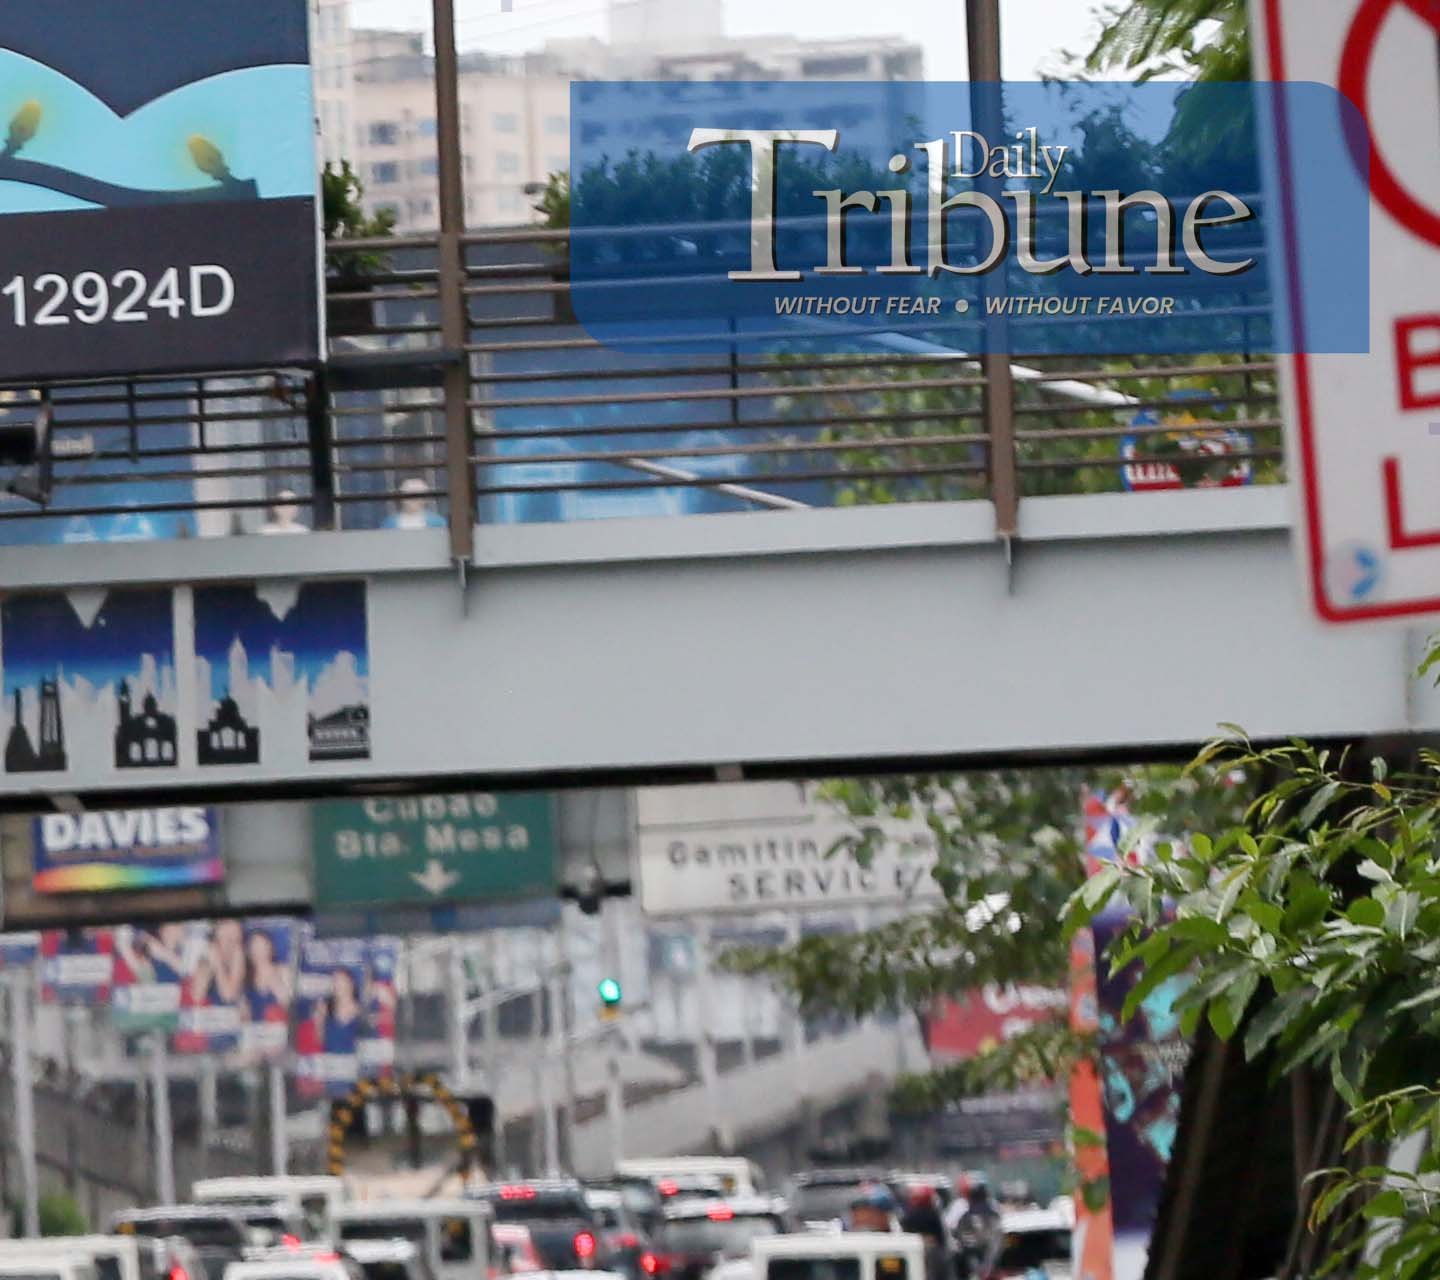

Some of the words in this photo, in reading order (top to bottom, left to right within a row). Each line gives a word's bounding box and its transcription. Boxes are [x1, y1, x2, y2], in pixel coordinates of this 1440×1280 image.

[364, 792, 500, 823] Cubao
[42, 807, 212, 853] DAVIES
[334, 830, 411, 859] Sta.
[425, 822, 529, 855] Mesa
[668, 837, 821, 867] Gamitin
